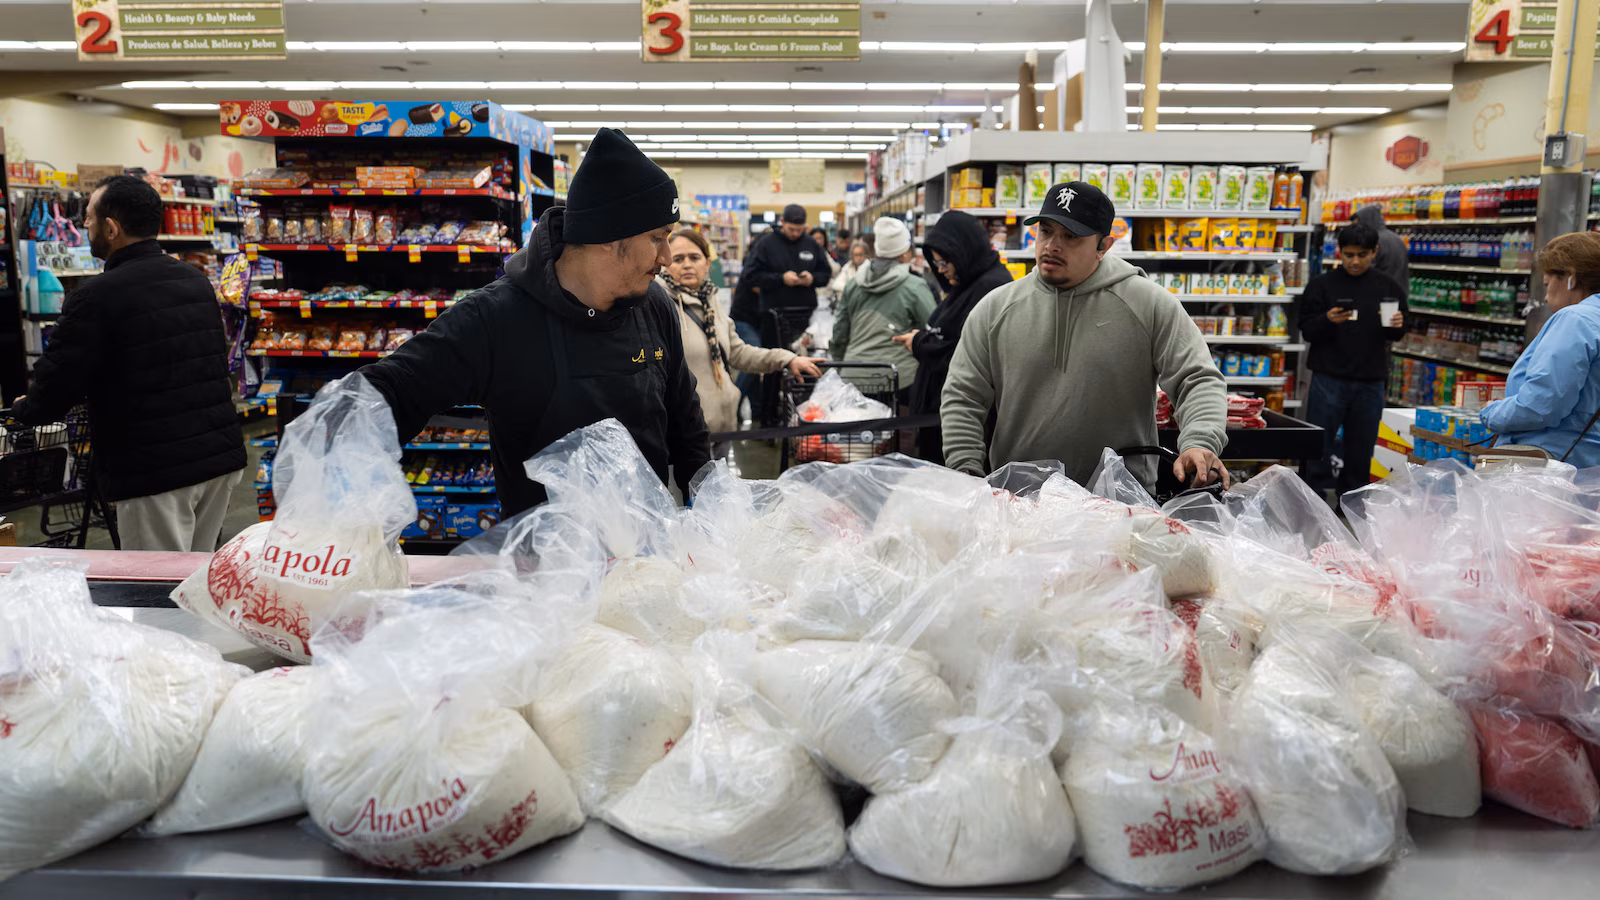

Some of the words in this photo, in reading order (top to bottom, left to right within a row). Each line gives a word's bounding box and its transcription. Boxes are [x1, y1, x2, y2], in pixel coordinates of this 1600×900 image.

[124, 13, 154, 23] Health
[155, 14, 163, 23] &
[165, 13, 195, 25] Beauty
[196, 13, 204, 22] &
[206, 12, 227, 25] Baby
[229, 12, 256, 22] Needs
[694, 14, 719, 24] Hielo
[721, 15, 747, 24] Nieve
[748, 15, 756, 23] &
[758, 14, 792, 24] Comida
[793, 14, 839, 26] Congelada
[1526, 13, 1556, 24] Papita
[77, 11, 117, 53] 2
[647, 12, 685, 55] 3
[1474, 10, 1514, 54] 4
[128, 39, 170, 49] Productos
[171, 39, 183, 49] de
[211, 38, 243, 48] Belleza
[244, 41, 250, 51] y
[252, 38, 277, 48] Bebes
[694, 42, 708, 51] Ice
[734, 42, 748, 51] Ice
[749, 42, 779, 51] Cream
[780, 43, 788, 51] &
[789, 42, 820, 51] Frozen
[822, 42, 843, 51] Food
[1517, 39, 1538, 49] Beer
[341, 106, 365, 115] TASTE
[263, 544, 352, 578] apola
[308, 576, 329, 587] 1961
